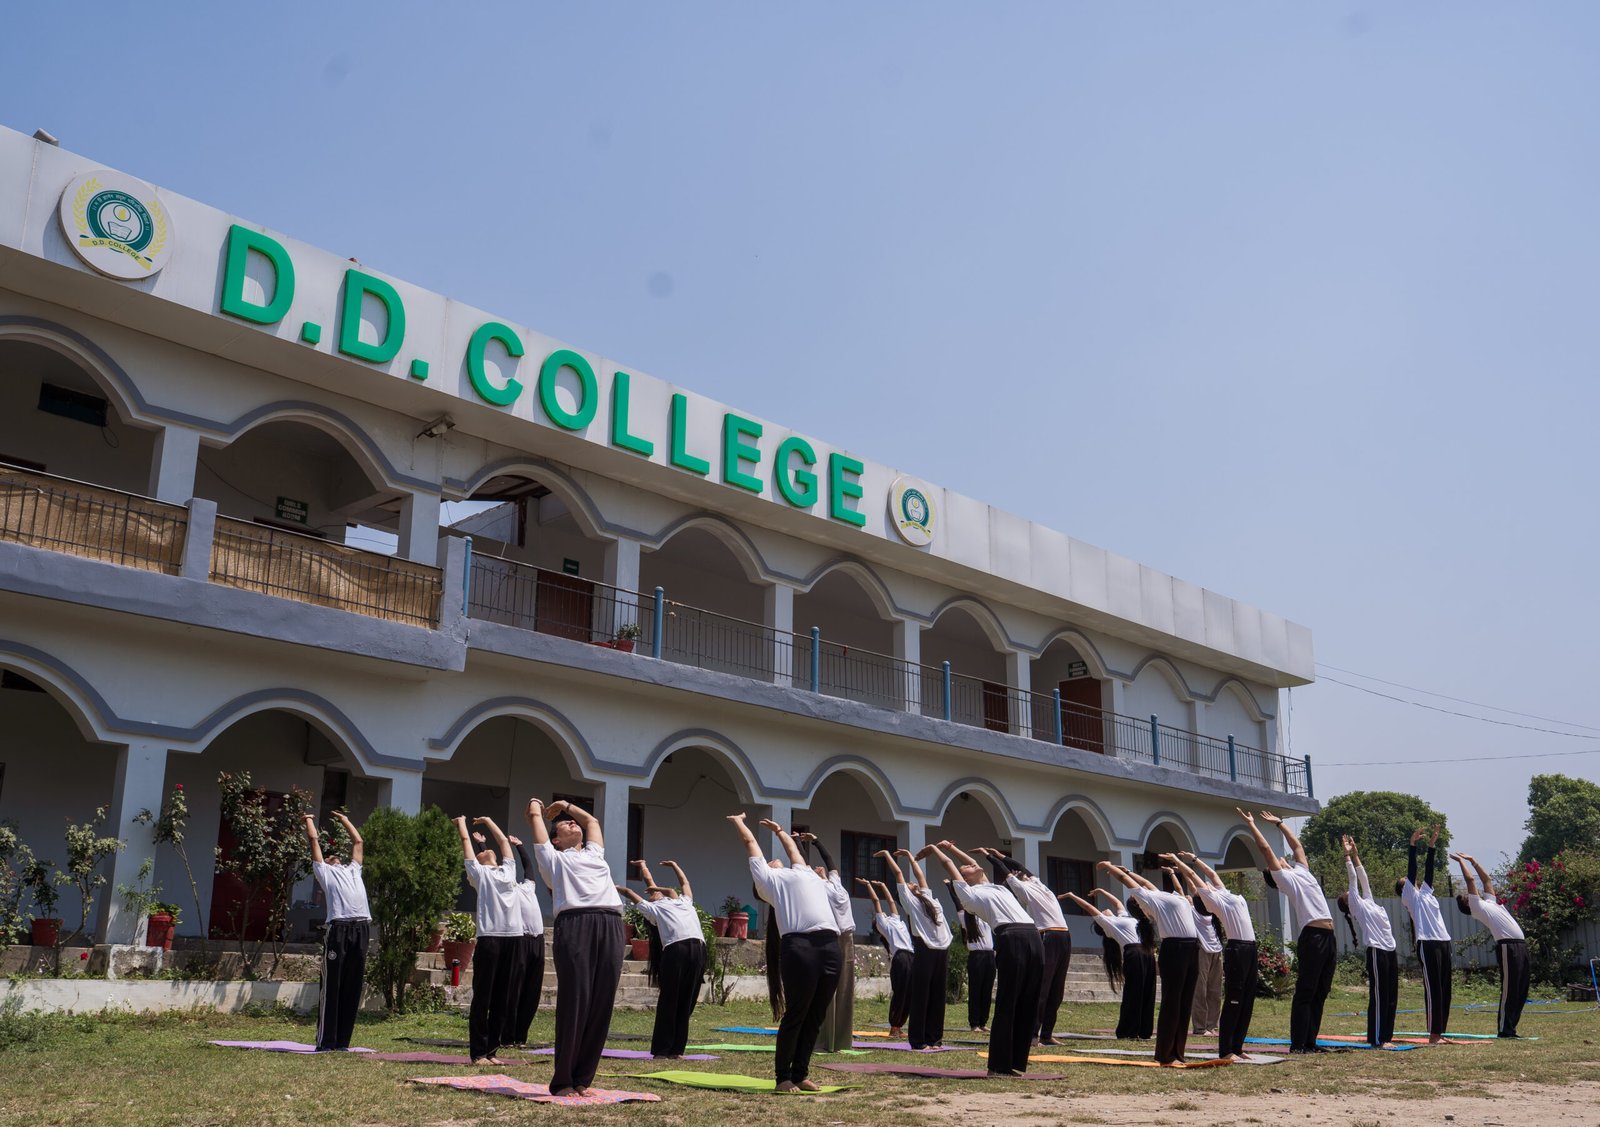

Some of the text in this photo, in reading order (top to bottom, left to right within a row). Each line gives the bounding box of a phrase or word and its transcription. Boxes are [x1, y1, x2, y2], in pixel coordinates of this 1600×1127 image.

[108, 240, 141, 260] COLLEGE
[220, 224, 866, 527] D.D. COLLEGE
